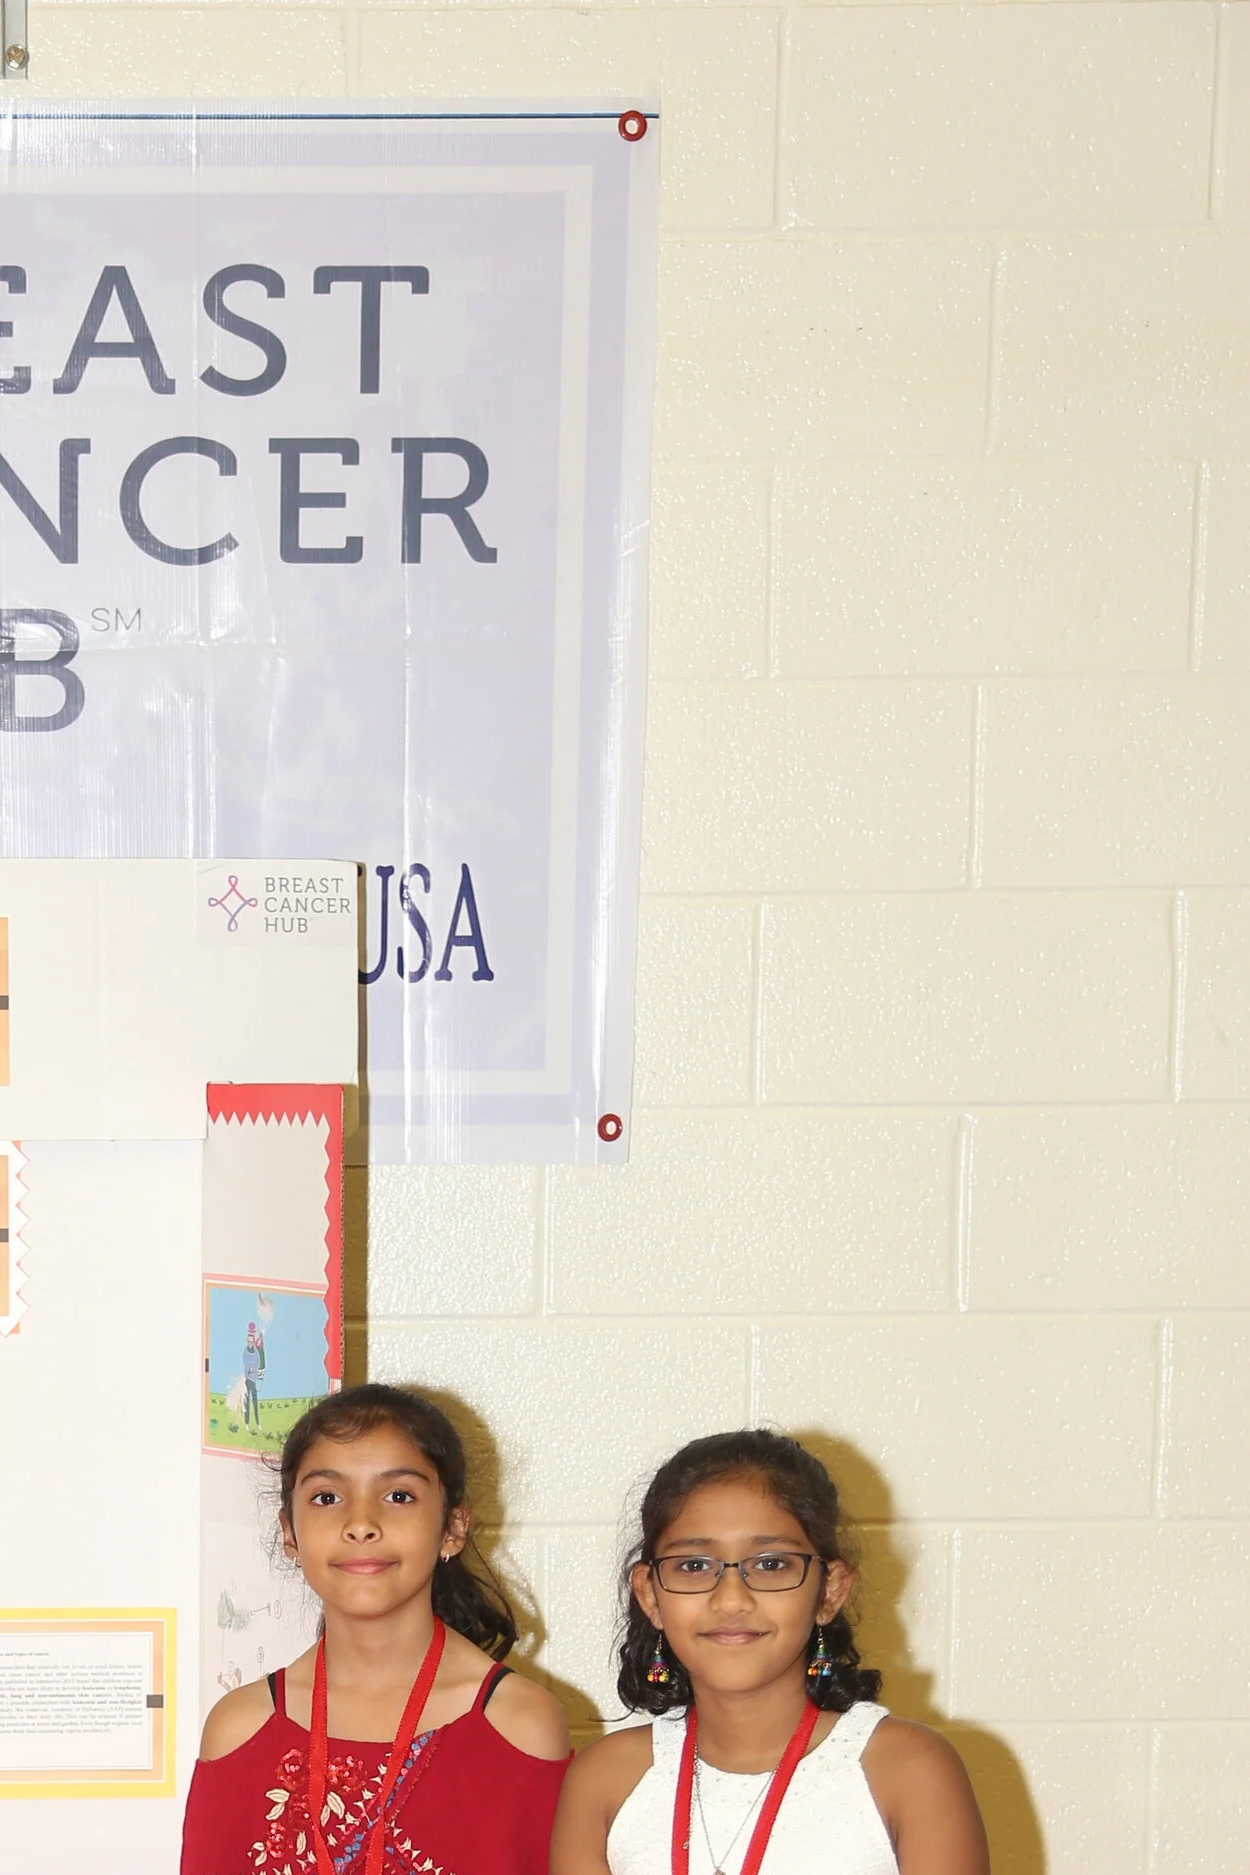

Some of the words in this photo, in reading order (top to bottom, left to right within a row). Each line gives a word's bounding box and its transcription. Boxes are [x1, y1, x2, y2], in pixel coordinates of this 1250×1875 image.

[264, 876, 344, 893] BREAST
[264, 897, 351, 914] CANCER
[264, 917, 309, 934] HUB
